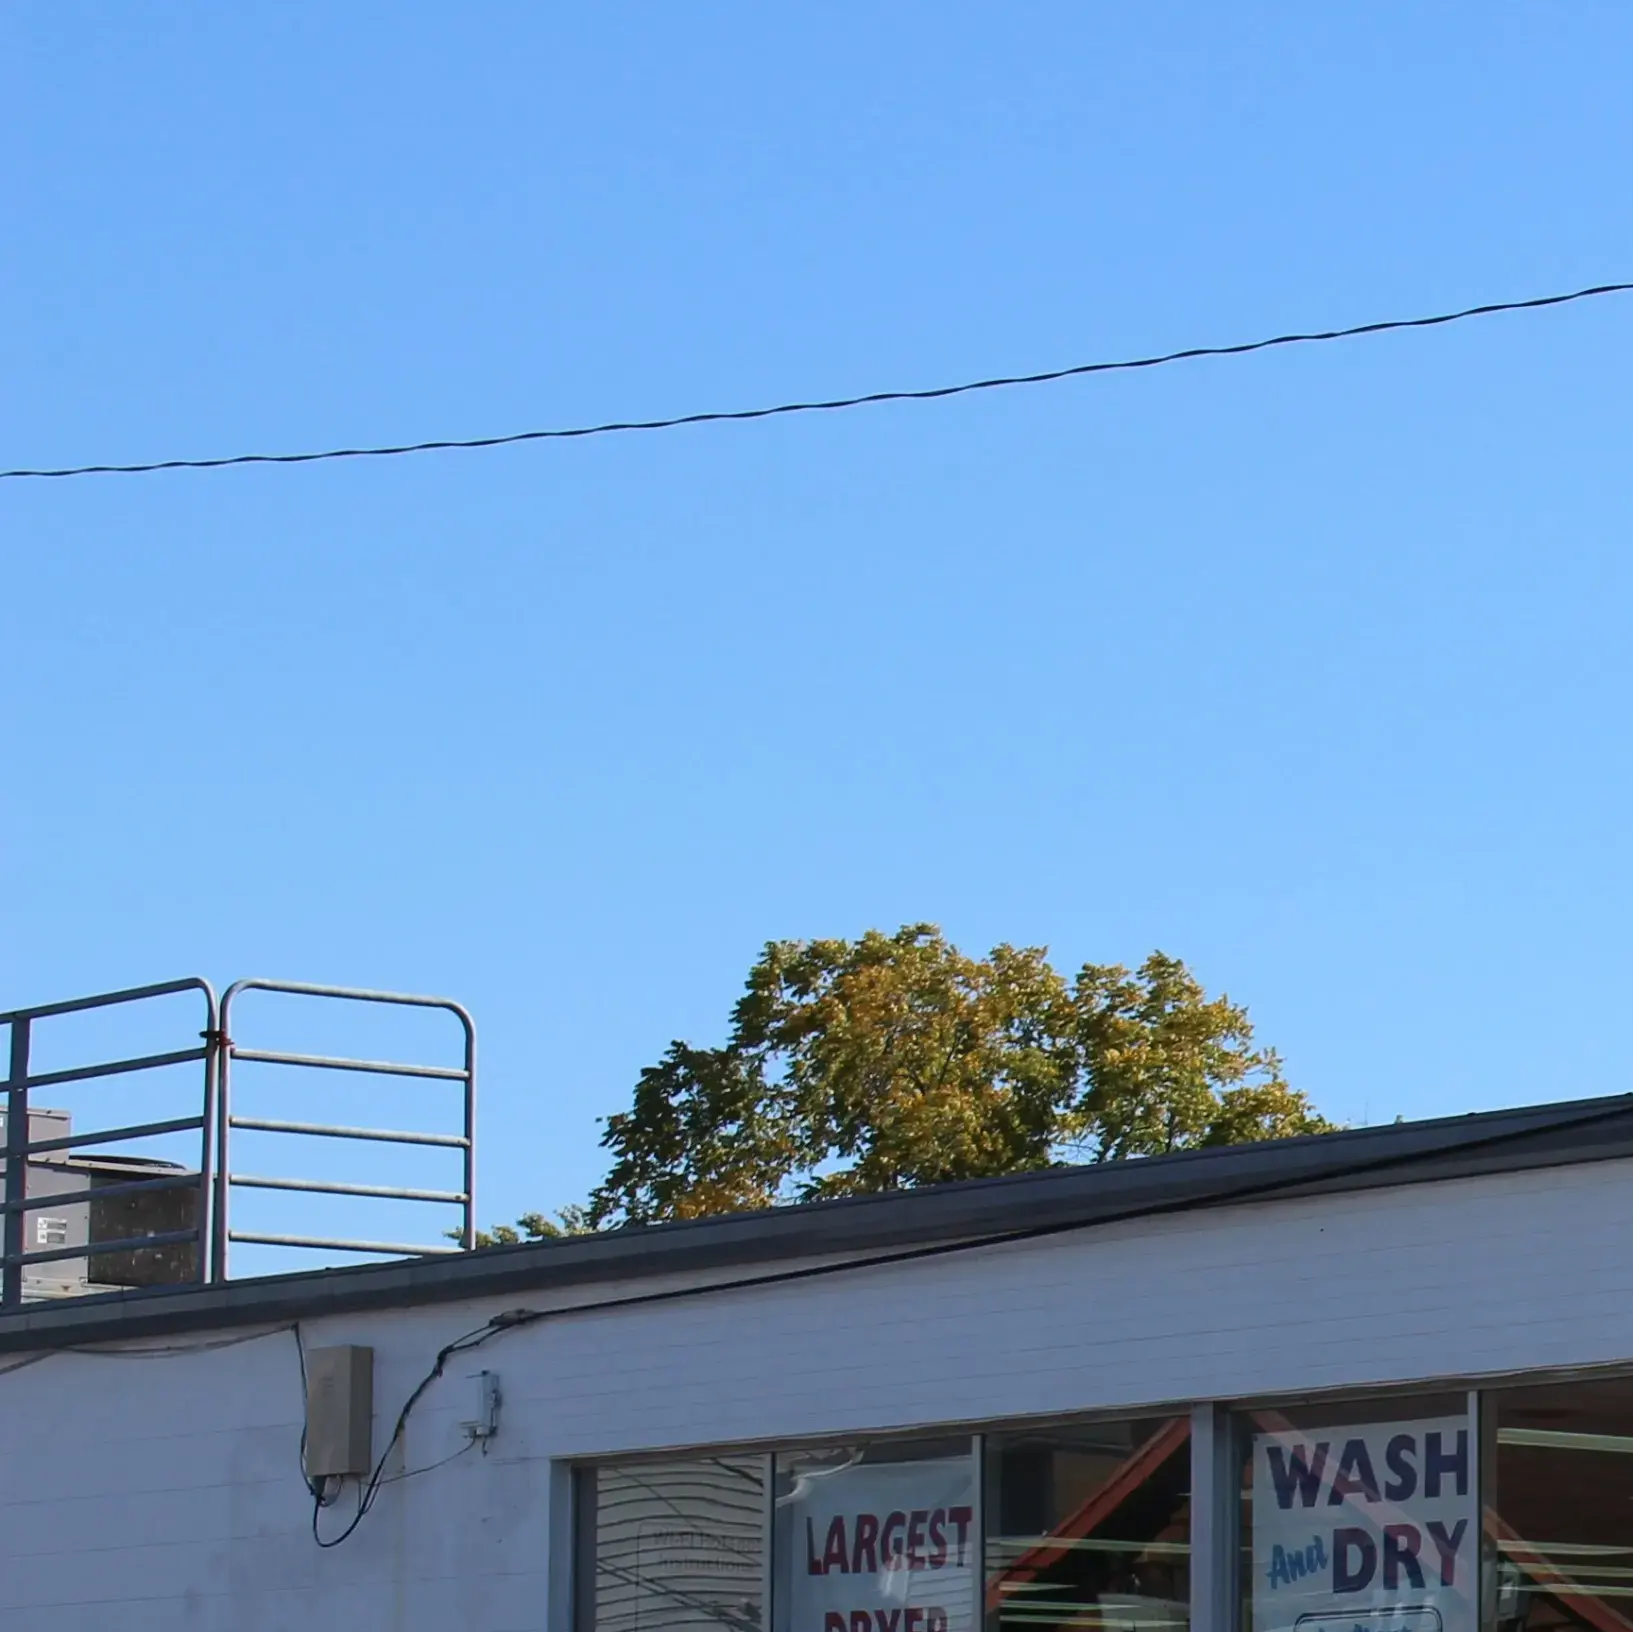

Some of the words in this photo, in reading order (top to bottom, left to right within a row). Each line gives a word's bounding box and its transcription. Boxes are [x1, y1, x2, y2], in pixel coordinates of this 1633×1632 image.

[1266, 1430, 1468, 1509] WASH
[806, 1506, 973, 1576] LARGEST
[1266, 1535, 1329, 1589] And
[1333, 1519, 1469, 1593] DRY
